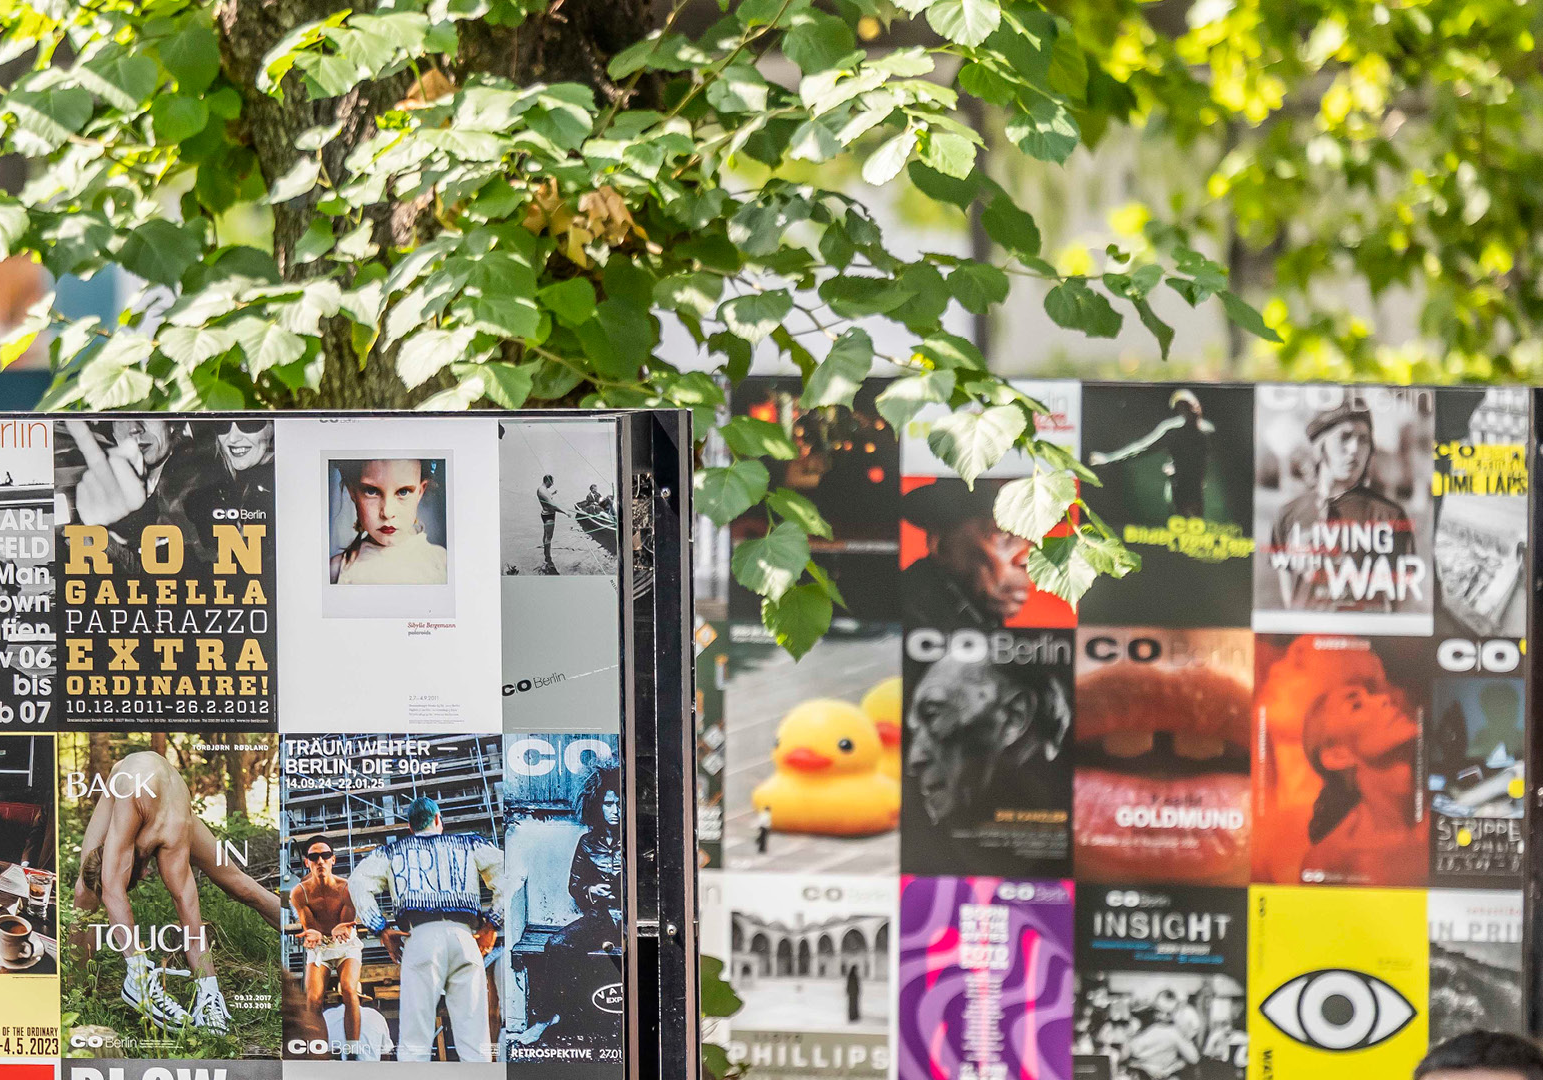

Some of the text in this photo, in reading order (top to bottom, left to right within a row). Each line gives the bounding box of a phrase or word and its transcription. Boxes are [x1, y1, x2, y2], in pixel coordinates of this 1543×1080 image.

[240, 508, 267, 521] Berlin
[64, 524, 267, 575] RON
[1288, 520, 1395, 555] LIVING
[1324, 554, 1426, 601] WAR
[65, 579, 268, 605] GALELLA
[65, 609, 268, 634] PAPARAZZO
[18, 647, 52, 669] 06
[66, 638, 269, 671] EXTRA
[992, 632, 1072, 666] Berlin
[13, 672, 52, 696] bis
[65, 676, 270, 696] ORDINAIRE!
[21, 701, 52, 724] 07
[285, 738, 431, 757] TRÄUM WEITER
[285, 758, 439, 776] BERLIN, DIE 90er
[66, 770, 157, 799] BACK
[1115, 805, 1244, 830] GOLDMUND
[215, 839, 249, 868] IN
[88, 923, 206, 953] TOUCH
[1093, 910, 1232, 942] INSIGHT
[233, 994, 272, 1002] 09.12.2017
[2, 1026, 11, 1037] OF
[12, 1026, 25, 1037] THE
[27, 1027, 58, 1037] ORDINARY
[105, 1036, 138, 1049] Berlin
[330, 1040, 371, 1055] Berlin
[511, 1048, 592, 1059] RETROSPEKTIVE
